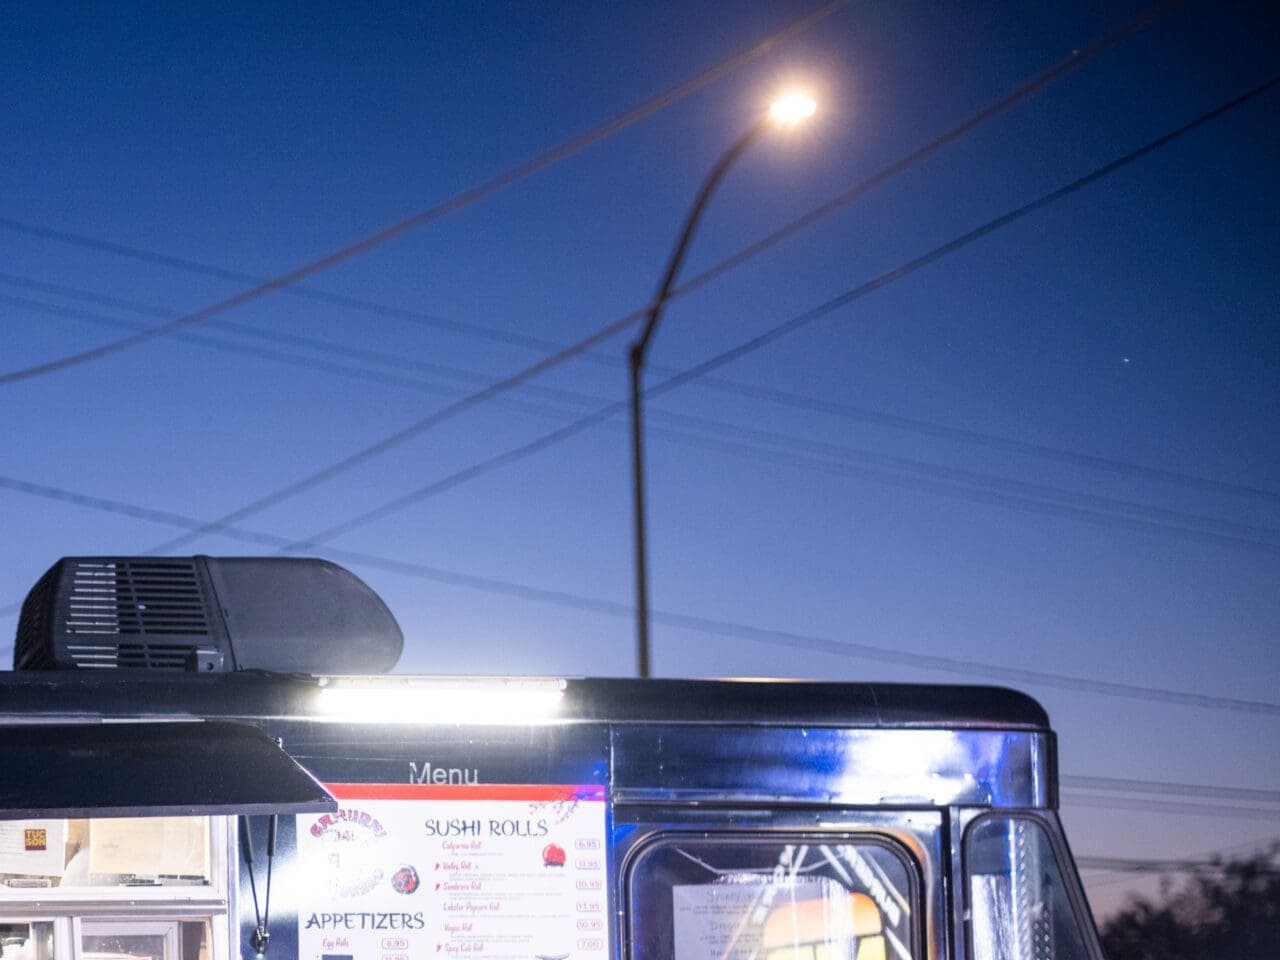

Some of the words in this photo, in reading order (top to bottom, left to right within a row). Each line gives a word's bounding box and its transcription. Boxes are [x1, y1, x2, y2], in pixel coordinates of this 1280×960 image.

[410, 762, 478, 785] Menu
[425, 820, 481, 836] SUSHI
[490, 819, 548, 836] ROLLS
[305, 913, 424, 929] APPETIZERS
